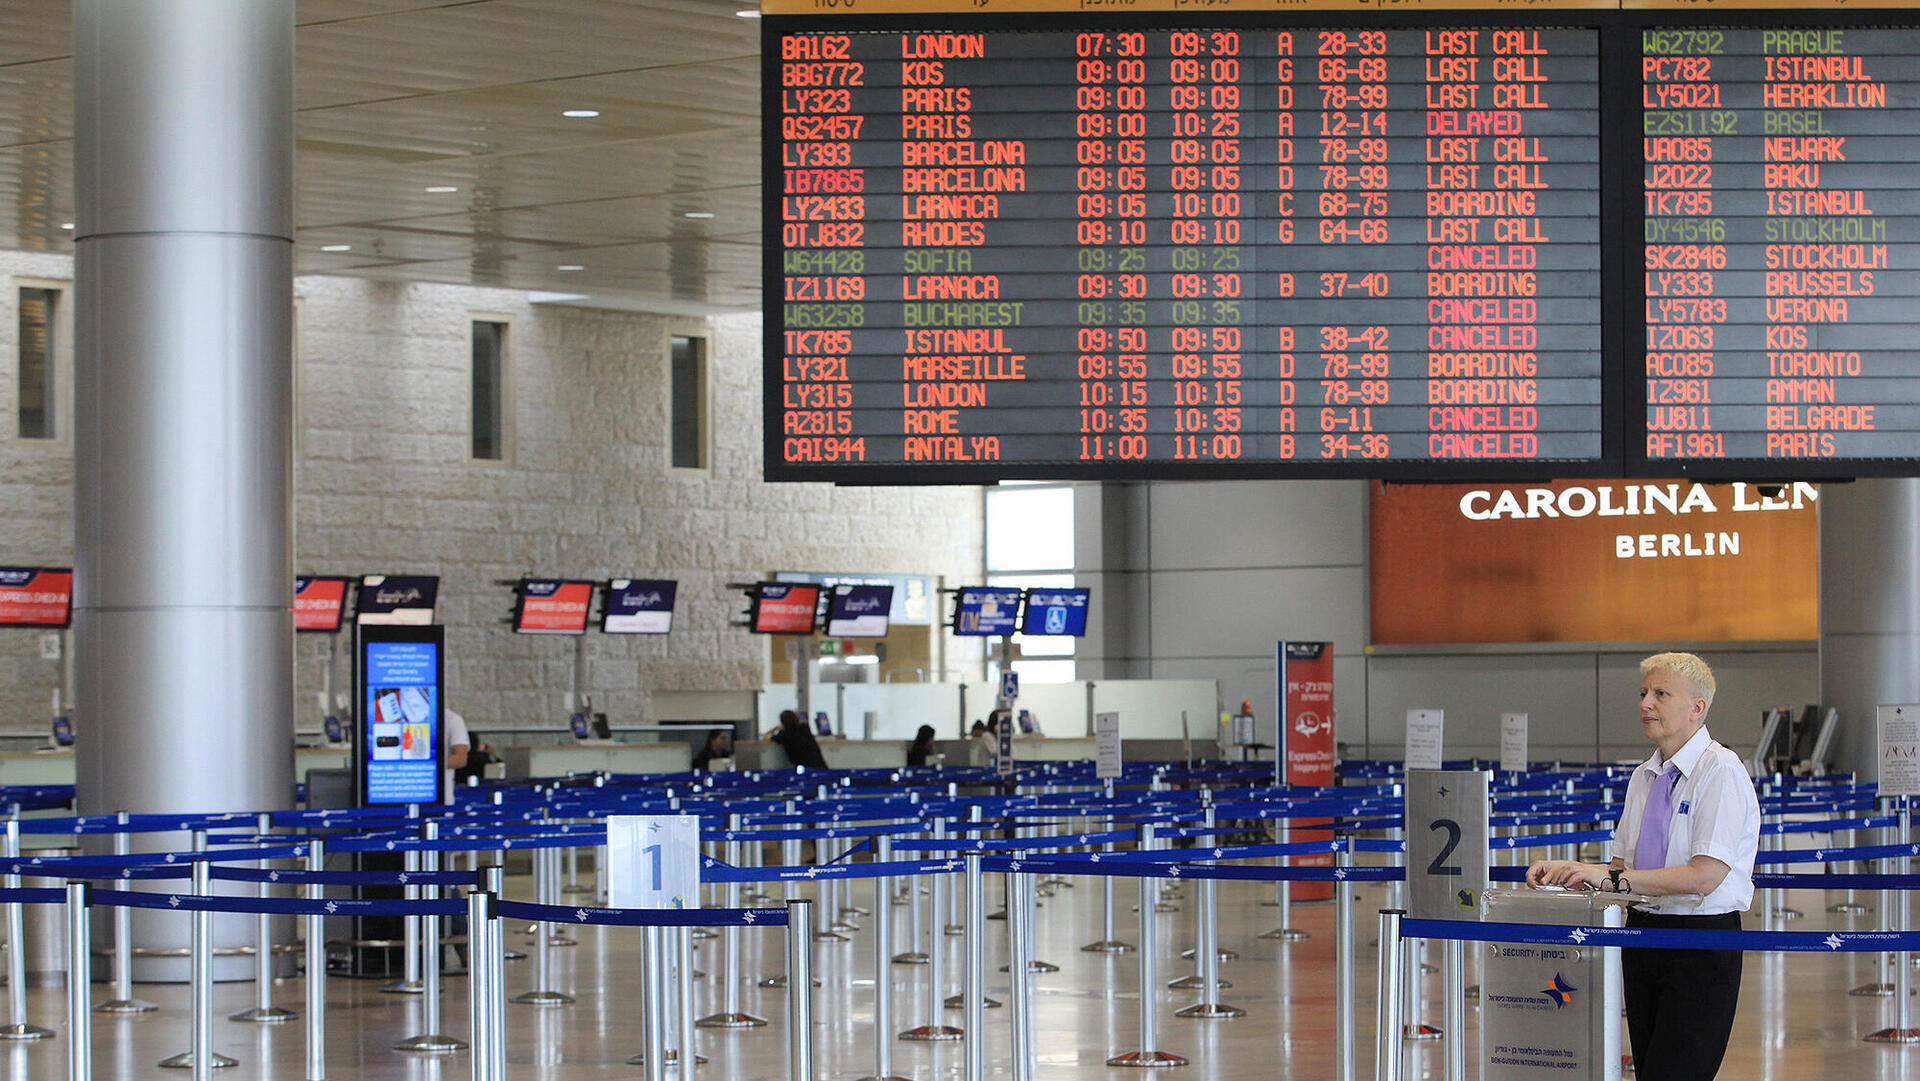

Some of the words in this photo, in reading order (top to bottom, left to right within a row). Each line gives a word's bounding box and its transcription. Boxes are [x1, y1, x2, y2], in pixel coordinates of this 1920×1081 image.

[782, 35, 851, 61] BA162
[902, 34, 984, 59] LONDON
[1076, 32, 1145, 57] 07:30
[1170, 32, 1239, 56] 09:30
[1278, 32, 1293, 56] A
[1318, 31, 1387, 55] 28-33
[1426, 30, 1479, 55] LAST
[1493, 30, 1548, 55] CALL
[1642, 30, 1723, 54] W62792
[1763, 30, 1844, 54] PRAGUE
[782, 62, 864, 86] BBG772
[902, 61, 944, 85] KOS
[1077, 59, 1145, 84] 09:00
[1170, 58, 1239, 83] 09:00
[1278, 58, 1293, 82] G
[1318, 58, 1387, 82] G6-G8
[1426, 57, 1479, 82] LAST
[1493, 57, 1548, 82] CALL
[1643, 57, 1711, 81] PC782
[1765, 56, 1872, 81] ISTANBUL
[782, 88, 851, 113] LY323
[902, 88, 971, 112] PARIS
[1077, 86, 1145, 110] 09:00
[1171, 86, 1240, 110] 09:09
[1278, 85, 1293, 109] D
[1319, 84, 1387, 109] 78-99
[1426, 84, 1480, 108] LAST
[1494, 84, 1549, 108] CALL
[1643, 84, 1722, 108] LY5021
[1764, 83, 1885, 107] HERAKLION
[782, 115, 864, 140] QS2457
[902, 114, 971, 138] PARIS
[1077, 112, 1146, 137] 09:00
[1173, 112, 1240, 136] 10:25
[1279, 112, 1293, 136] A
[1321, 111, 1387, 136] 12-14
[1427, 111, 1522, 136] DELAYED
[1643, 111, 1738, 135] EZS1192
[1764, 110, 1830, 134] BASEL
[782, 142, 851, 166] LY393
[903, 141, 1026, 166] BARCELONA
[1077, 139, 1145, 164] 09:05
[1171, 139, 1240, 163] 09:05
[1279, 139, 1293, 162] D
[1320, 138, 1387, 162] 78-99
[1426, 137, 1480, 162] LAST
[1494, 137, 1548, 162] CALL
[1643, 137, 1712, 161] UA085
[1765, 137, 1846, 161] NEWARK
[784, 169, 864, 193] IB7865
[903, 167, 1025, 192] BARCELONA
[1077, 167, 1146, 191] 09:05
[1171, 166, 1240, 190] 09:05
[1279, 166, 1293, 189] D
[1320, 165, 1388, 189] 78-99
[1427, 164, 1480, 189] LAST
[1494, 164, 1549, 189] CALL
[1644, 164, 1712, 188] J2022
[1765, 164, 1819, 188] BAKU
[782, 195, 865, 220] LY2433
[903, 194, 998, 219] LARNACA
[1077, 193, 1146, 217] 09:05
[1173, 193, 1240, 217] 10:00
[1279, 193, 1294, 216] C
[1320, 192, 1388, 216] 68-75
[1427, 191, 1536, 215] BOARDING
[1644, 191, 1712, 214] TK795
[1767, 191, 1872, 215] ISTANBUL
[903, 221, 985, 246] RHODES
[1077, 220, 1146, 244] 09:10
[1171, 220, 1240, 244] 09:10
[1279, 219, 1294, 243] G
[1320, 219, 1388, 243] G4-G6
[1427, 218, 1480, 242] LAST
[1494, 218, 1549, 242] CALL
[1644, 219, 1725, 241] DY4546
[1766, 218, 1886, 243] STOCKHOLM
[784, 250, 864, 274] W64428
[904, 249, 972, 273] SOFIA
[1078, 247, 1145, 271] 09:25
[1173, 247, 1240, 270] 09:25
[1428, 245, 1536, 269] CANCELED
[1645, 245, 1727, 269] SK2846
[1766, 244, 1887, 268] STOCKHOLM
[784, 276, 865, 301] IZ1169
[903, 275, 999, 299] LARNACA
[1078, 274, 1146, 298] 09:30
[1172, 274, 1240, 297] 09:30
[1280, 273, 1294, 296] B
[1321, 273, 1388, 296] 37-40
[1428, 272, 1536, 296] BOARDING
[1645, 272, 1713, 295] LY333
[1766, 271, 1874, 296] BRUSSELS
[784, 304, 864, 327] W63258
[904, 302, 1024, 327] BUCHAREST
[1078, 301, 1146, 325] 09:35
[1173, 301, 1240, 324] 09:35
[1428, 299, 1537, 323] CANCELED
[1646, 299, 1727, 322] LY5783
[1767, 298, 1847, 322] VERONA
[784, 330, 852, 354] TK785
[905, 329, 1012, 353] ISTANBUL
[1078, 328, 1146, 352] 09:50
[1172, 328, 1241, 351] 09:50
[1280, 327, 1294, 350] B
[1321, 326, 1389, 350] 38-42
[1428, 326, 1537, 350] CANCELED
[1648, 326, 1714, 349] IZ063
[1767, 325, 1807, 349] KOS
[783, 357, 849, 381] LY321
[903, 355, 1026, 381] MARSEILLE
[1078, 354, 1147, 379] 09:55
[1172, 354, 1241, 378] 09:55
[1280, 354, 1295, 378] D
[1320, 353, 1389, 378] 78-99
[1428, 352, 1537, 377] BOARDING
[1646, 352, 1714, 376] AC085
[1768, 352, 1861, 376] TORONTO
[783, 383, 852, 408] LY315
[904, 382, 986, 407] LONDON
[1080, 381, 1147, 406] 10:15
[1174, 381, 1241, 405] 10:15
[1280, 381, 1295, 405] D
[1321, 380, 1389, 404] 78-99
[1428, 379, 1537, 404] BOARDING
[1648, 380, 1710, 403] IZ961
[1767, 379, 1835, 402] AMMAN
[784, 411, 852, 434] AZ815
[904, 410, 959, 434] ROME
[1080, 408, 1147, 433] 10:35
[1175, 408, 1241, 432] 10:35
[1280, 408, 1295, 432] A
[1321, 407, 1373, 432] 6-11
[1429, 406, 1537, 431] CANCELED
[1646, 406, 1711, 430] JU811
[1767, 406, 1875, 430] BELGRADE
[784, 437, 865, 462] CAI944
[904, 436, 1000, 460] ANTALYA
[1080, 435, 1147, 460] 11:00
[1174, 435, 1241, 459] 11:00
[1280, 435, 1295, 458] B
[1321, 434, 1389, 458] 34-36
[1429, 433, 1537, 458] CANCELED
[1647, 433, 1725, 457] AF1961
[1767, 432, 1835, 456] PARIS
[1459, 481, 1717, 520] CAROLINA
[1616, 532, 1740, 558] BERLIN
[1427, 819, 1462, 876] 2
[641, 844, 662, 891] 1
[1502, 948, 1534, 958] SECURITY
